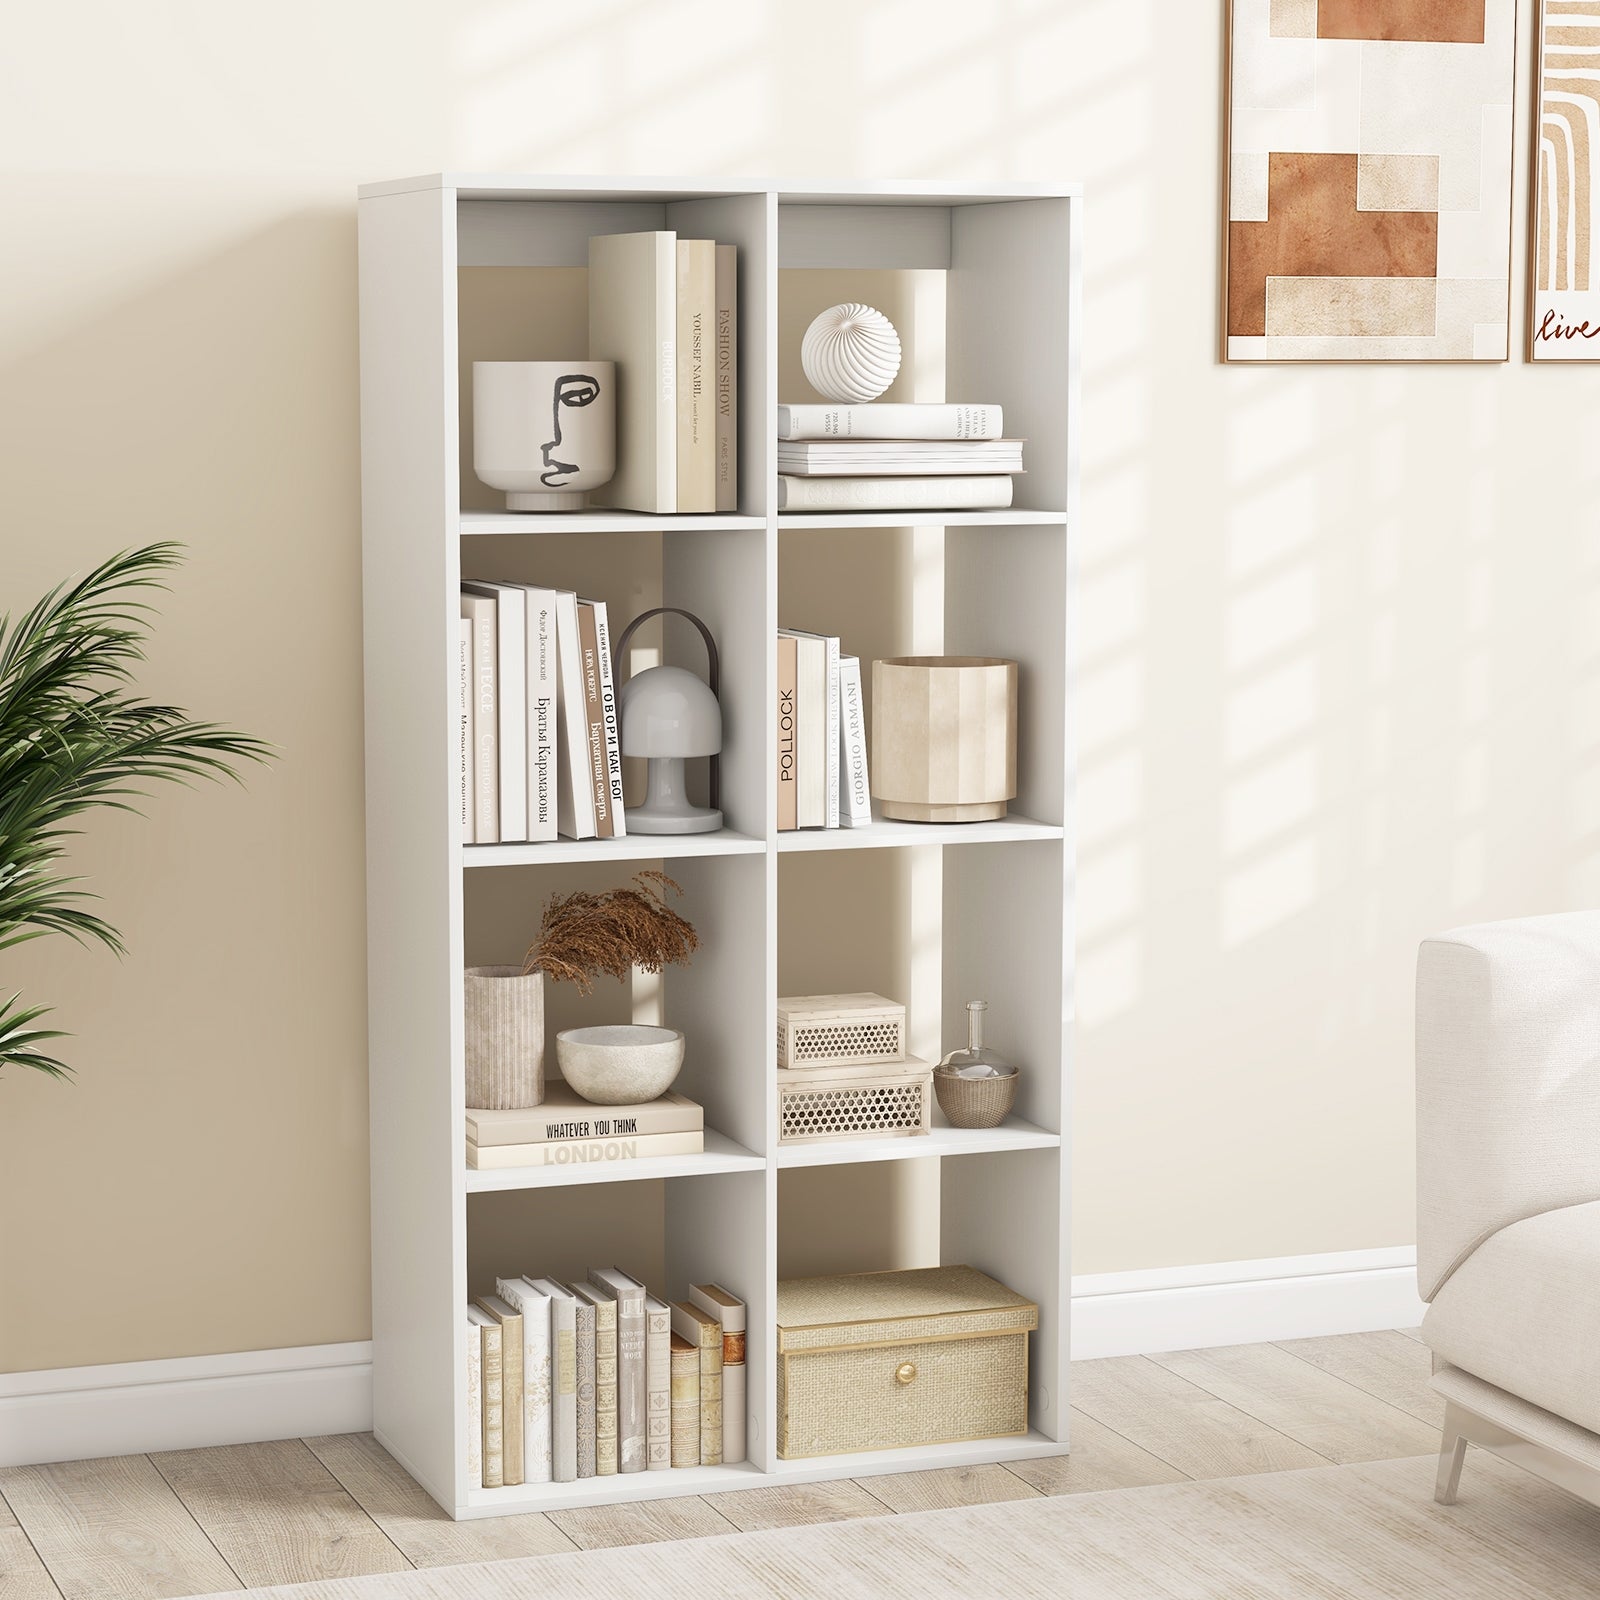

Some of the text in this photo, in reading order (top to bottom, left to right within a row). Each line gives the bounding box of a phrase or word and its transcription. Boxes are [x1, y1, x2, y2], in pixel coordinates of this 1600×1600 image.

[662, 341, 674, 401] BURDOCK
[692, 313, 702, 398] YOUSSEF NABIL
[719, 309, 730, 417] FASHION SHOW
[720, 437, 729, 482] PARIS STYLE
[585, 649, 598, 703] НОРА РОБЕРТС
[599, 623, 609, 679] КСЕНИЯ ЧЕРНОВА
[480, 666, 493, 713] ГЕССЕ
[534, 698, 551, 823] Братья Карамазовы
[590, 722, 607, 820] Бархатная смерть
[603, 684, 622, 801] ГОВОРИ КАК БОГ
[780, 689, 793, 781] POLLOCK
[847, 682, 865, 806] GIORGIO ARMANI
[543, 1140, 638, 1166] LONDON
[546, 1118, 638, 1139] WHATEVER YOU THINK
